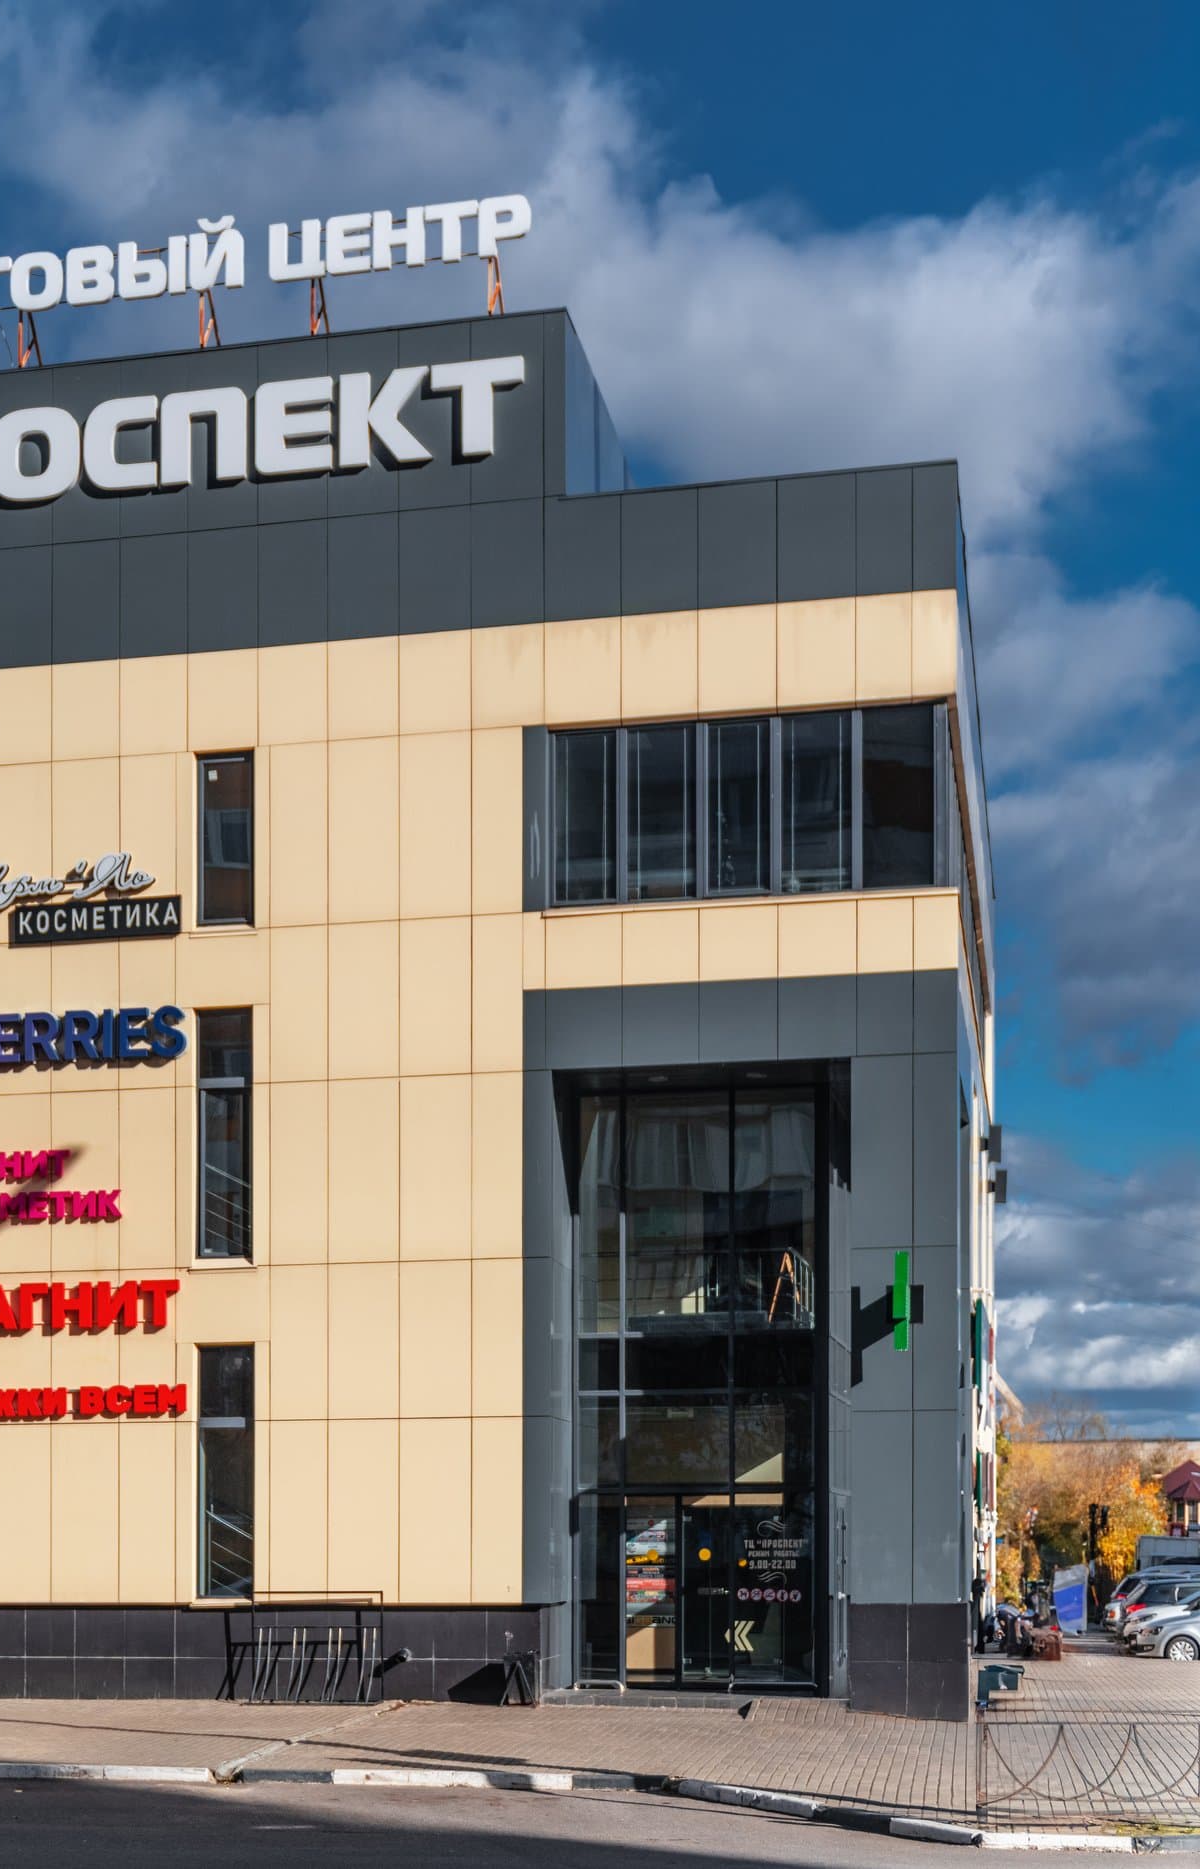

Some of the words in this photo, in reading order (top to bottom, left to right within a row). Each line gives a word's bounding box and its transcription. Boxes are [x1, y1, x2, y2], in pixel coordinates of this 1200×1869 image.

[268, 194, 532, 283] ЦЕНТР
[18, 901, 179, 935] КОСМЕТИКА
[77, 1384, 188, 1415] ВСЕМ
[743, 1539, 755, 1549] ТЦ
